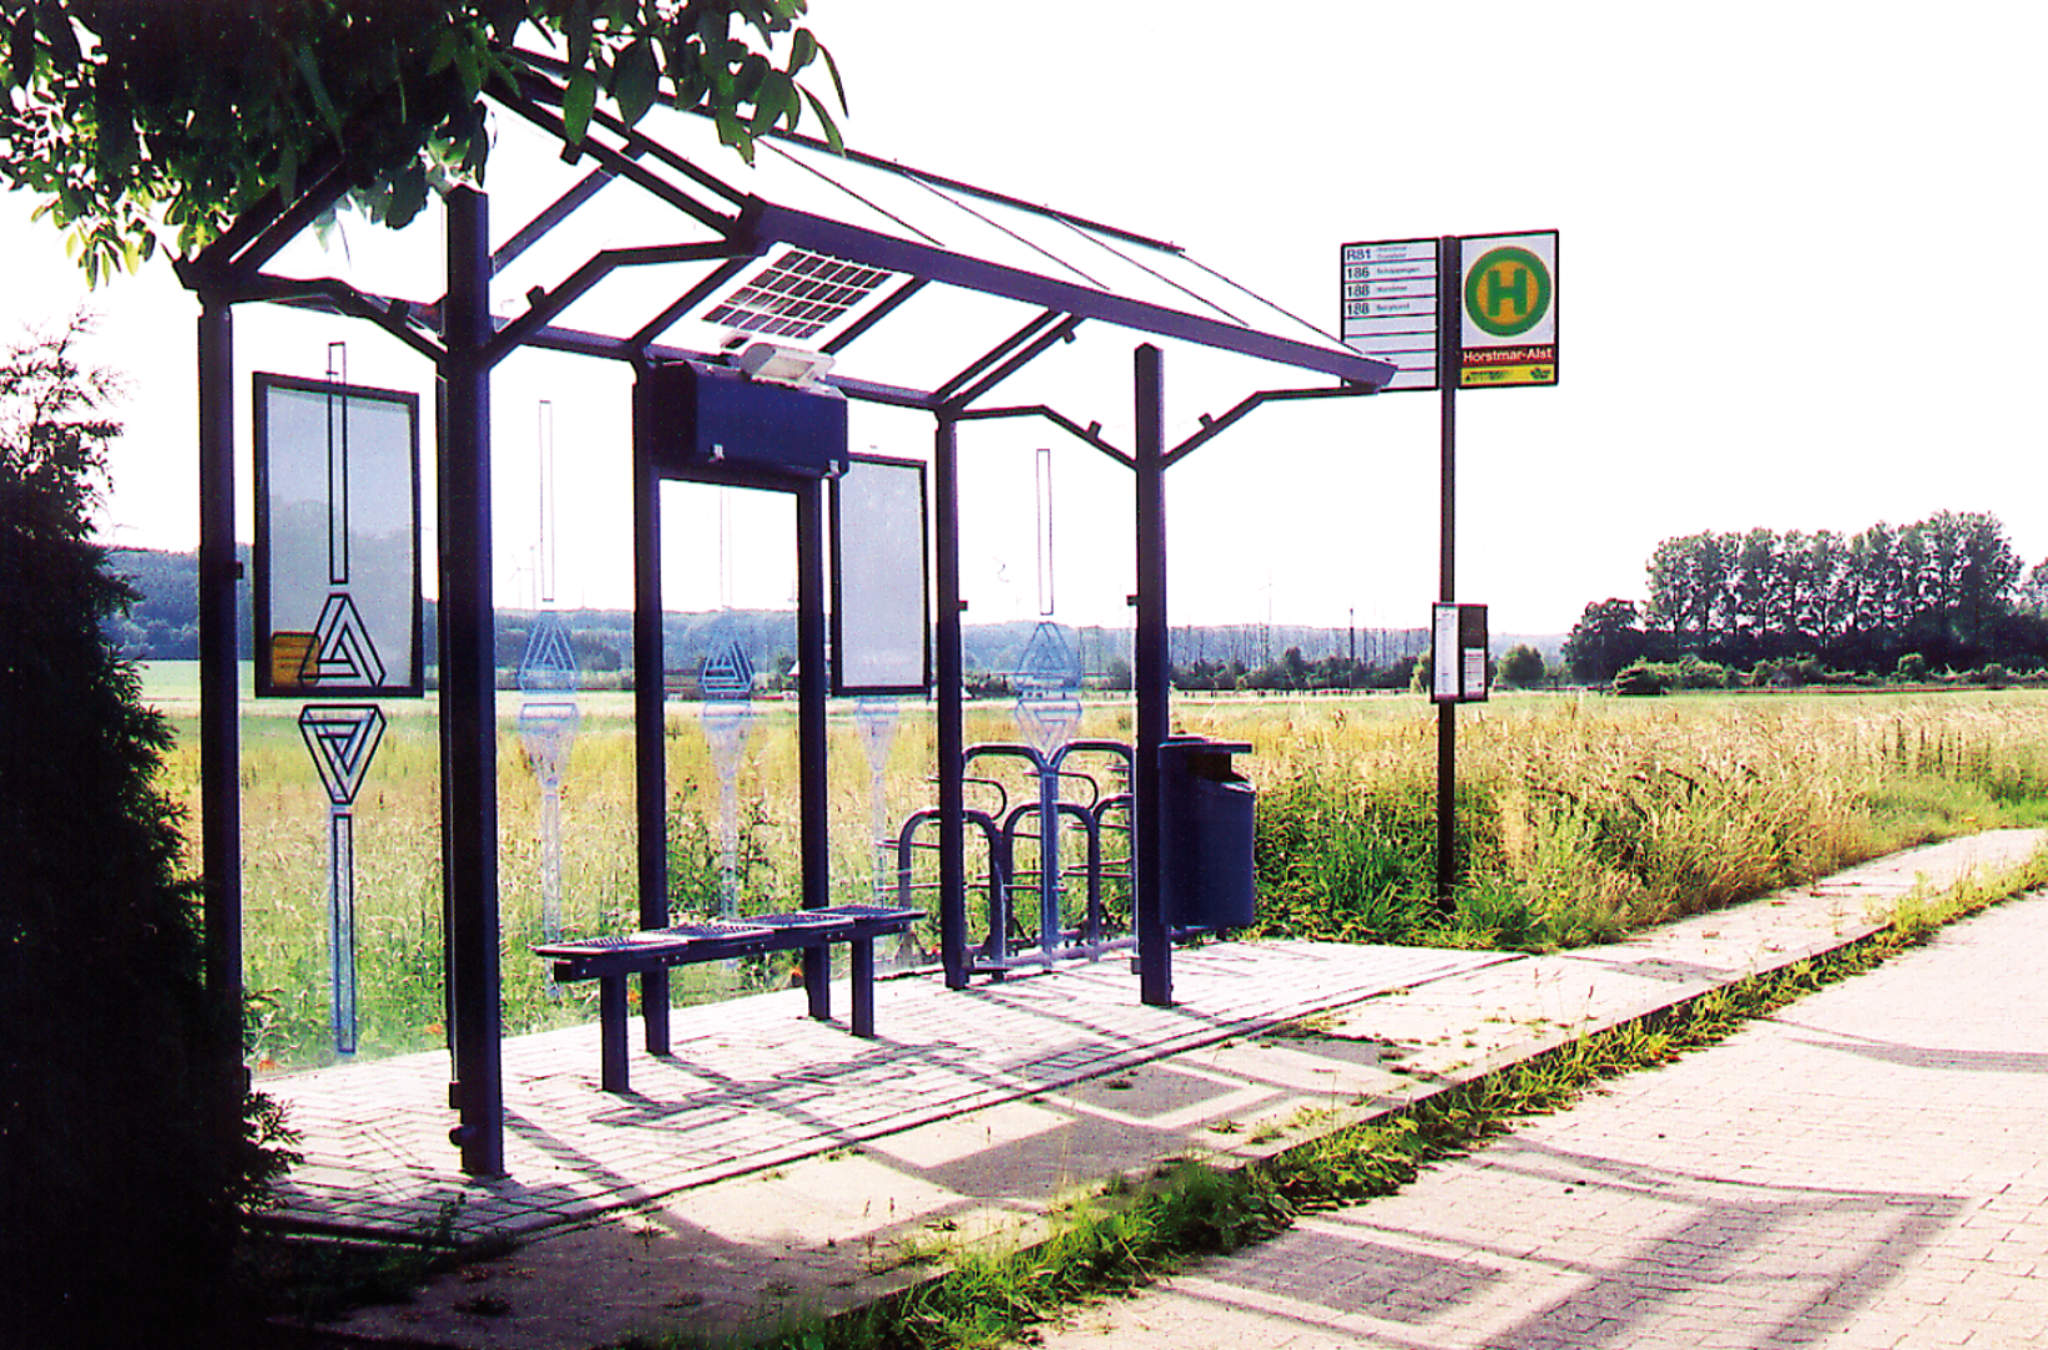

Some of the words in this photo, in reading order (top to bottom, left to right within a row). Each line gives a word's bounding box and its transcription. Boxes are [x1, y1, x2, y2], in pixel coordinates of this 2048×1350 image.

[1346, 247, 1371, 260] R81
[1347, 265, 1370, 279] 186
[1347, 283, 1370, 297] 188
[1487, 268, 1528, 318] H
[1347, 302, 1370, 315] 188
[1463, 347, 1553, 364] Horstmar-Alst
